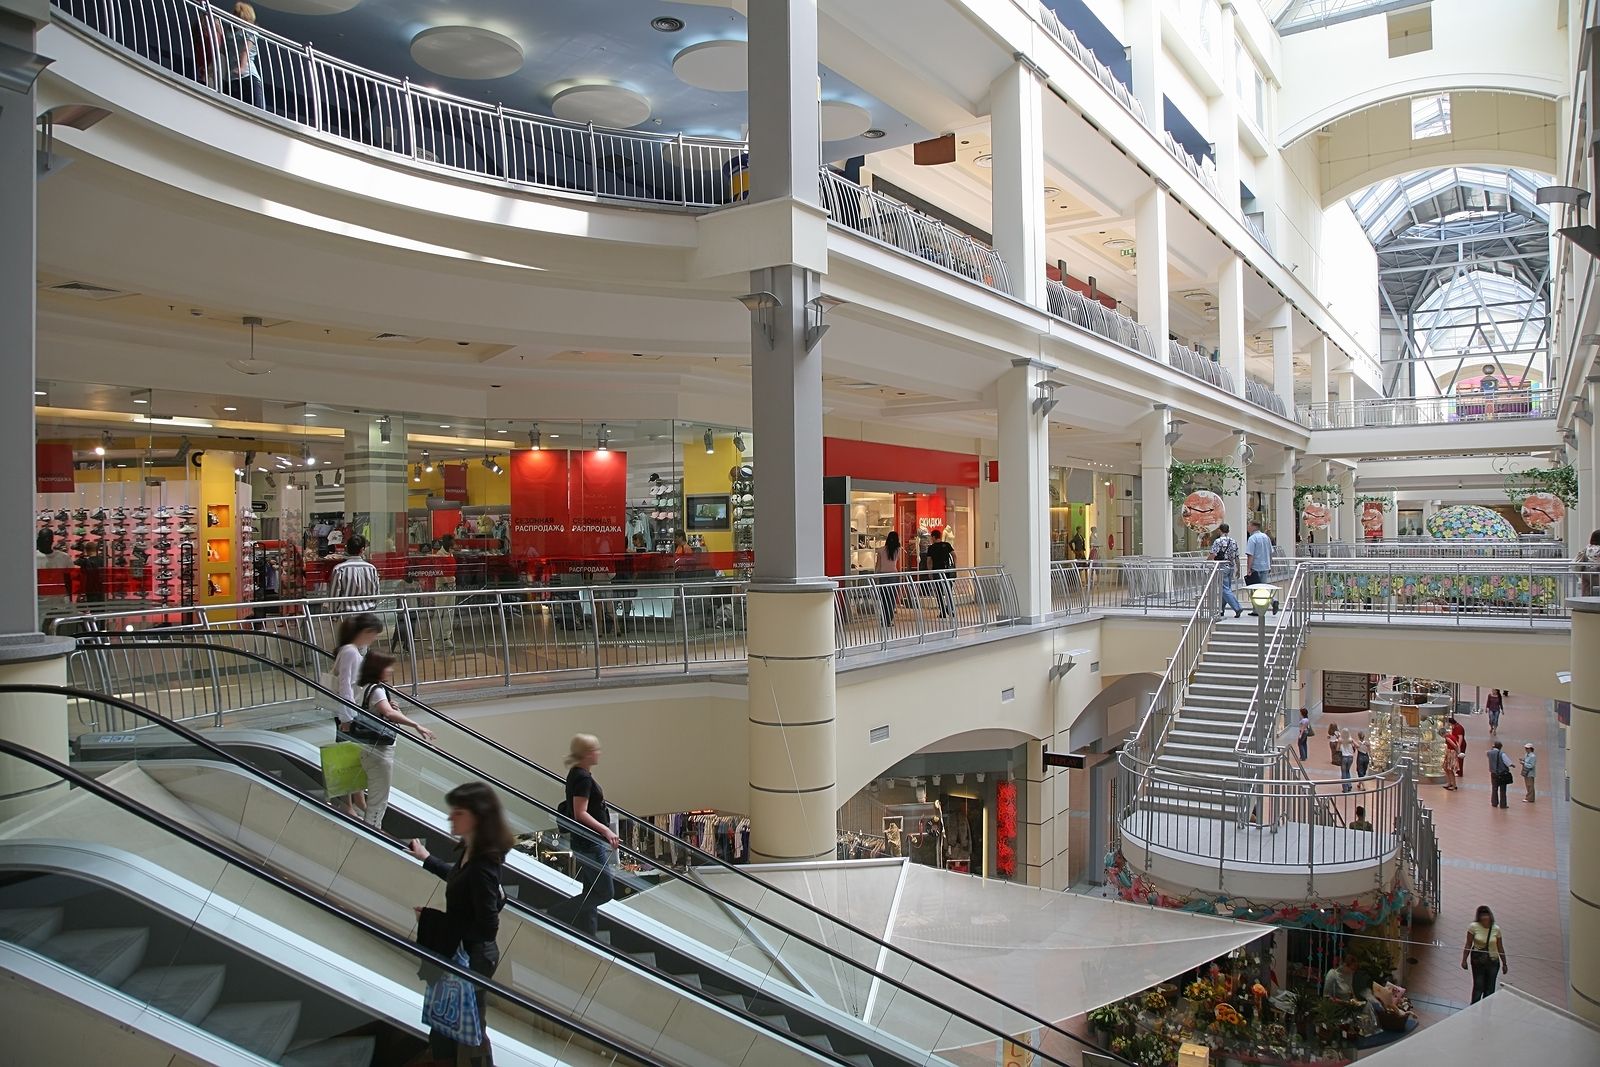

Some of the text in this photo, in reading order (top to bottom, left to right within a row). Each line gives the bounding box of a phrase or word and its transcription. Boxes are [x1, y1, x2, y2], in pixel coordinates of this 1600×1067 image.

[514, 517, 555, 525] СЕЗОННАЯ
[573, 517, 612, 525] СЕЗОННАЯ
[515, 525, 565, 533] РАСПРОДАЖА
[572, 525, 622, 533] РАСПРОДАЖА
